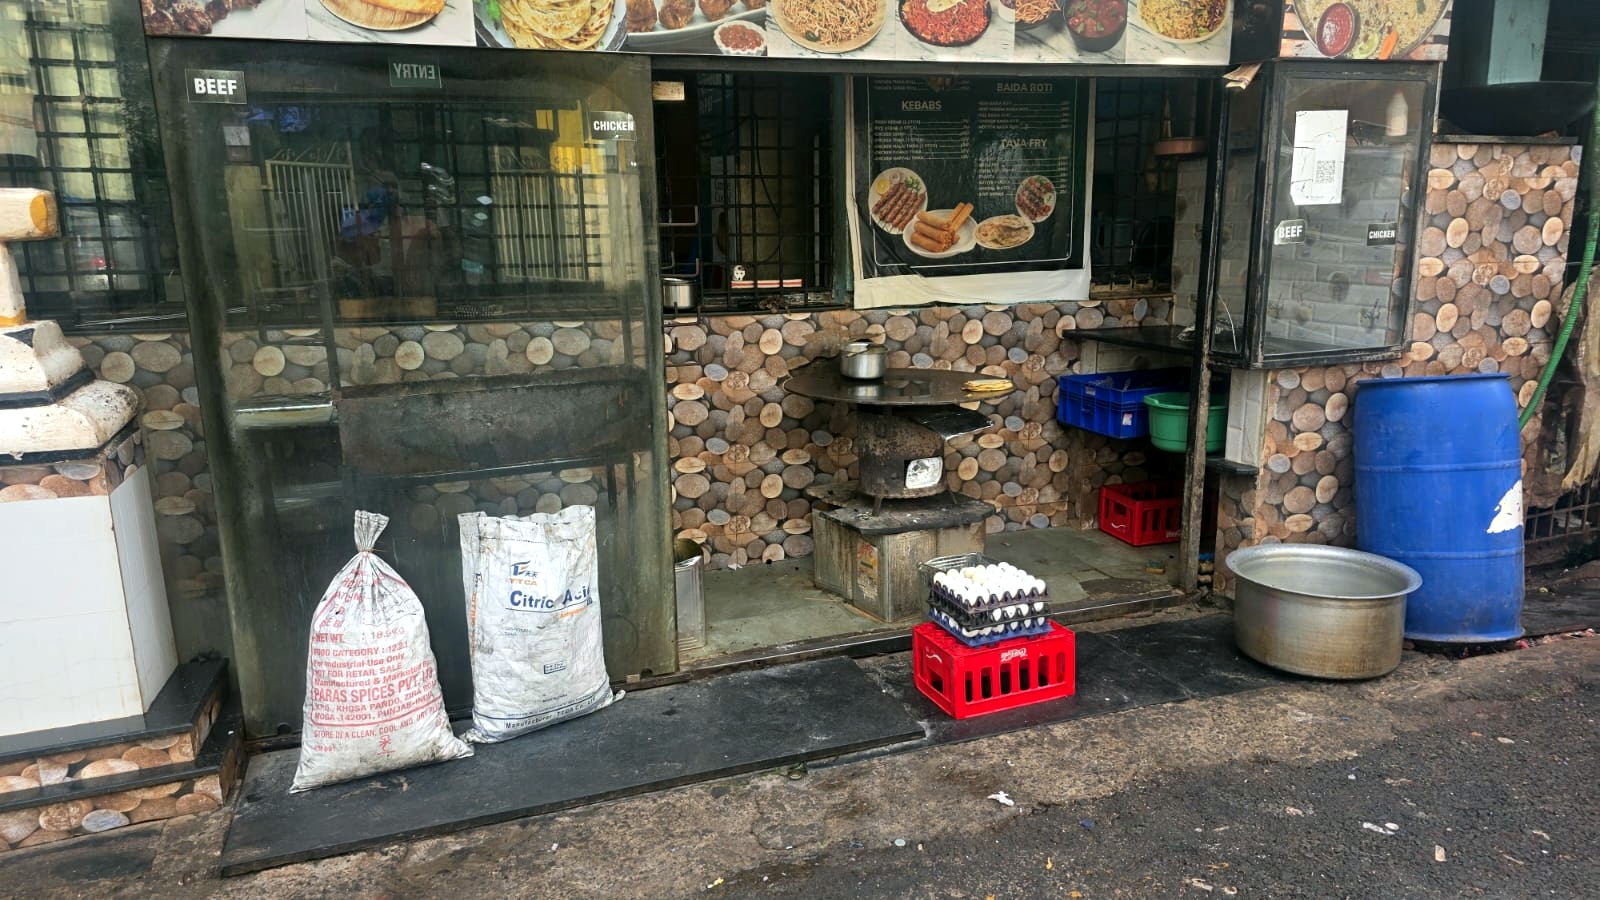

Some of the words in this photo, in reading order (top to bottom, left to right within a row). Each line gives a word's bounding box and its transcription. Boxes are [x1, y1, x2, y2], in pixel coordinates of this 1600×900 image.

[194, 78, 237, 95] BEEF
[997, 83, 1028, 92] BAIDA
[1030, 83, 1053, 92] ROTI
[902, 100, 942, 110] KEBABS
[593, 120, 635, 131] CHICKEN
[1029, 138, 1048, 148] FRY
[1279, 225, 1304, 239] BEEF
[1368, 229, 1396, 240] CHICKEN
[510, 589, 555, 609] Citric
[333, 646, 379, 657] CATEGORY
[386, 653, 405, 663] Only
[328, 670, 344, 678] FOR
[346, 668, 377, 678] RETAIL
[380, 663, 402, 675] SALE
[315, 679, 371, 688] Manufactured
[313, 687, 348, 703] PARAS
[350, 683, 395, 702] SPICES
[337, 704, 367, 713] KHOSA
[404, 689, 421, 701] ZIRA
[314, 729, 334, 738] STORE
[379, 723, 398, 734] COOL
[400, 717, 414, 729] AND
